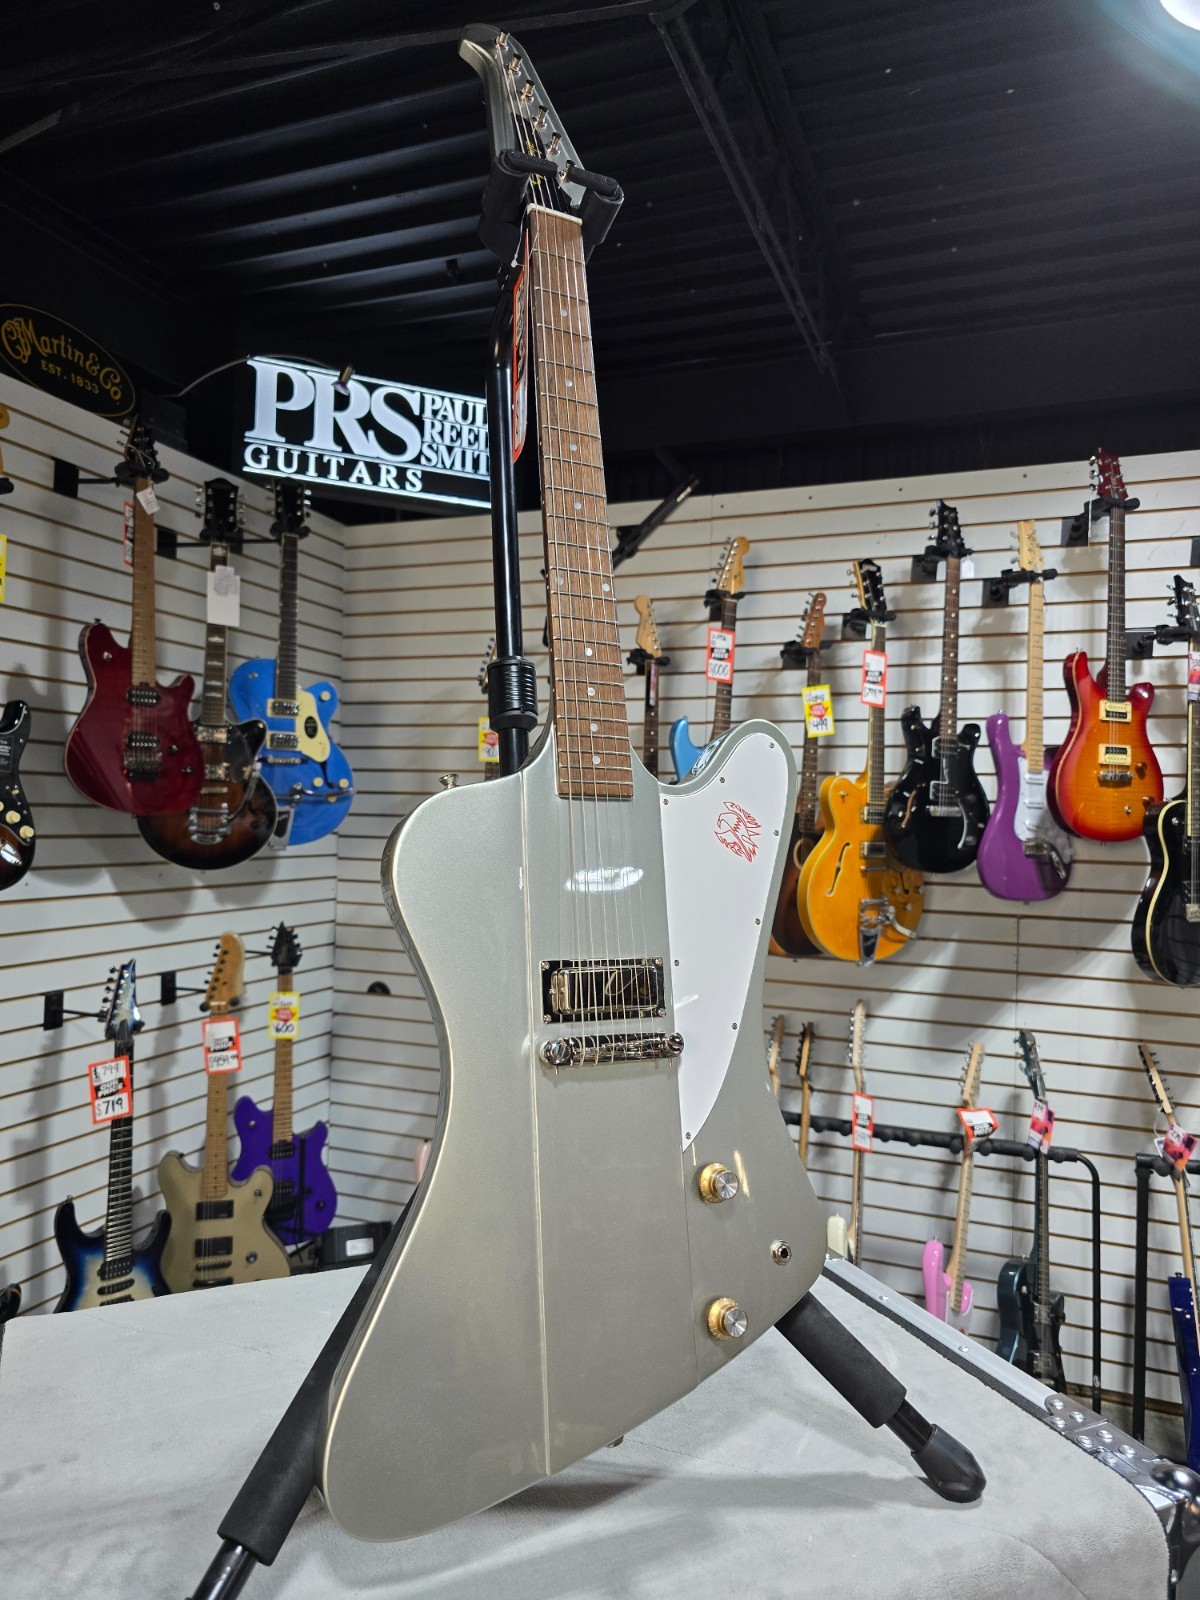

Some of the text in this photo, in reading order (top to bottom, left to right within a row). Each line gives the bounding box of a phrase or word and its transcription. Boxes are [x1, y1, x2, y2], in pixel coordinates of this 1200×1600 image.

[244, 359, 423, 463] PRS
[243, 442, 423, 493] GUITARS
[420, 440, 491, 476] SMIT
